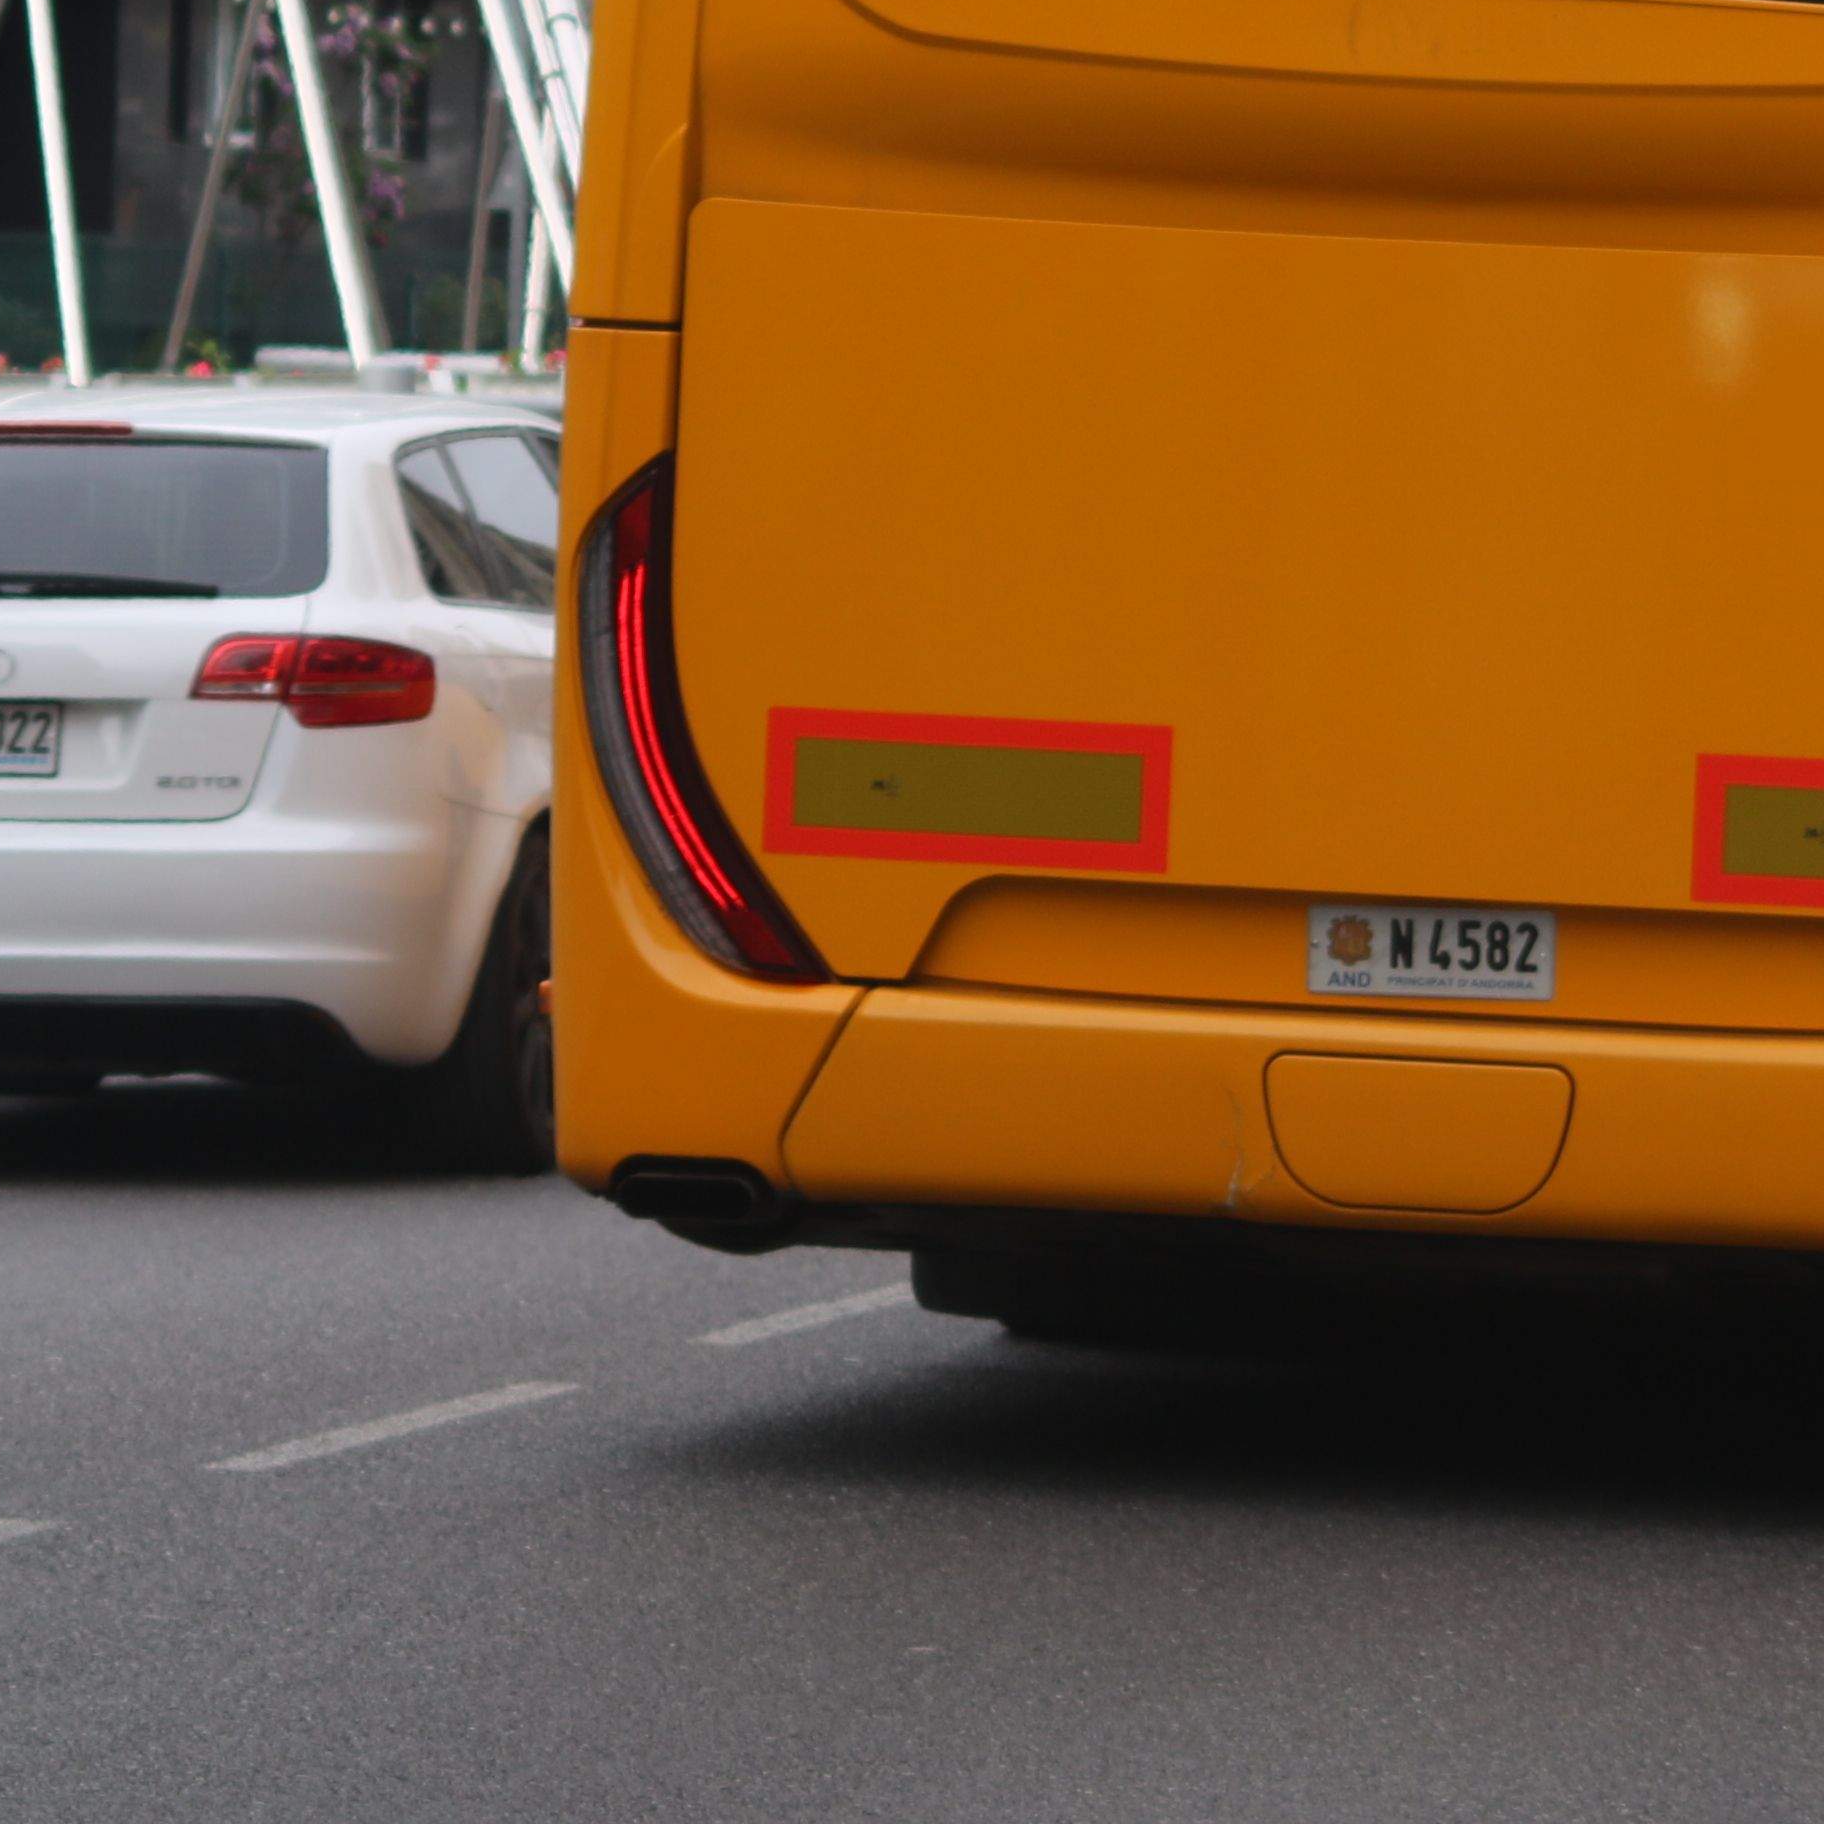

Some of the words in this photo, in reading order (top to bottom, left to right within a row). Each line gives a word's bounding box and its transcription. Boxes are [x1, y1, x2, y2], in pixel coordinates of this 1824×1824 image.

[1389, 917, 1414, 969] N
[1428, 918, 1539, 974] 4582
[1328, 971, 1371, 988] AND
